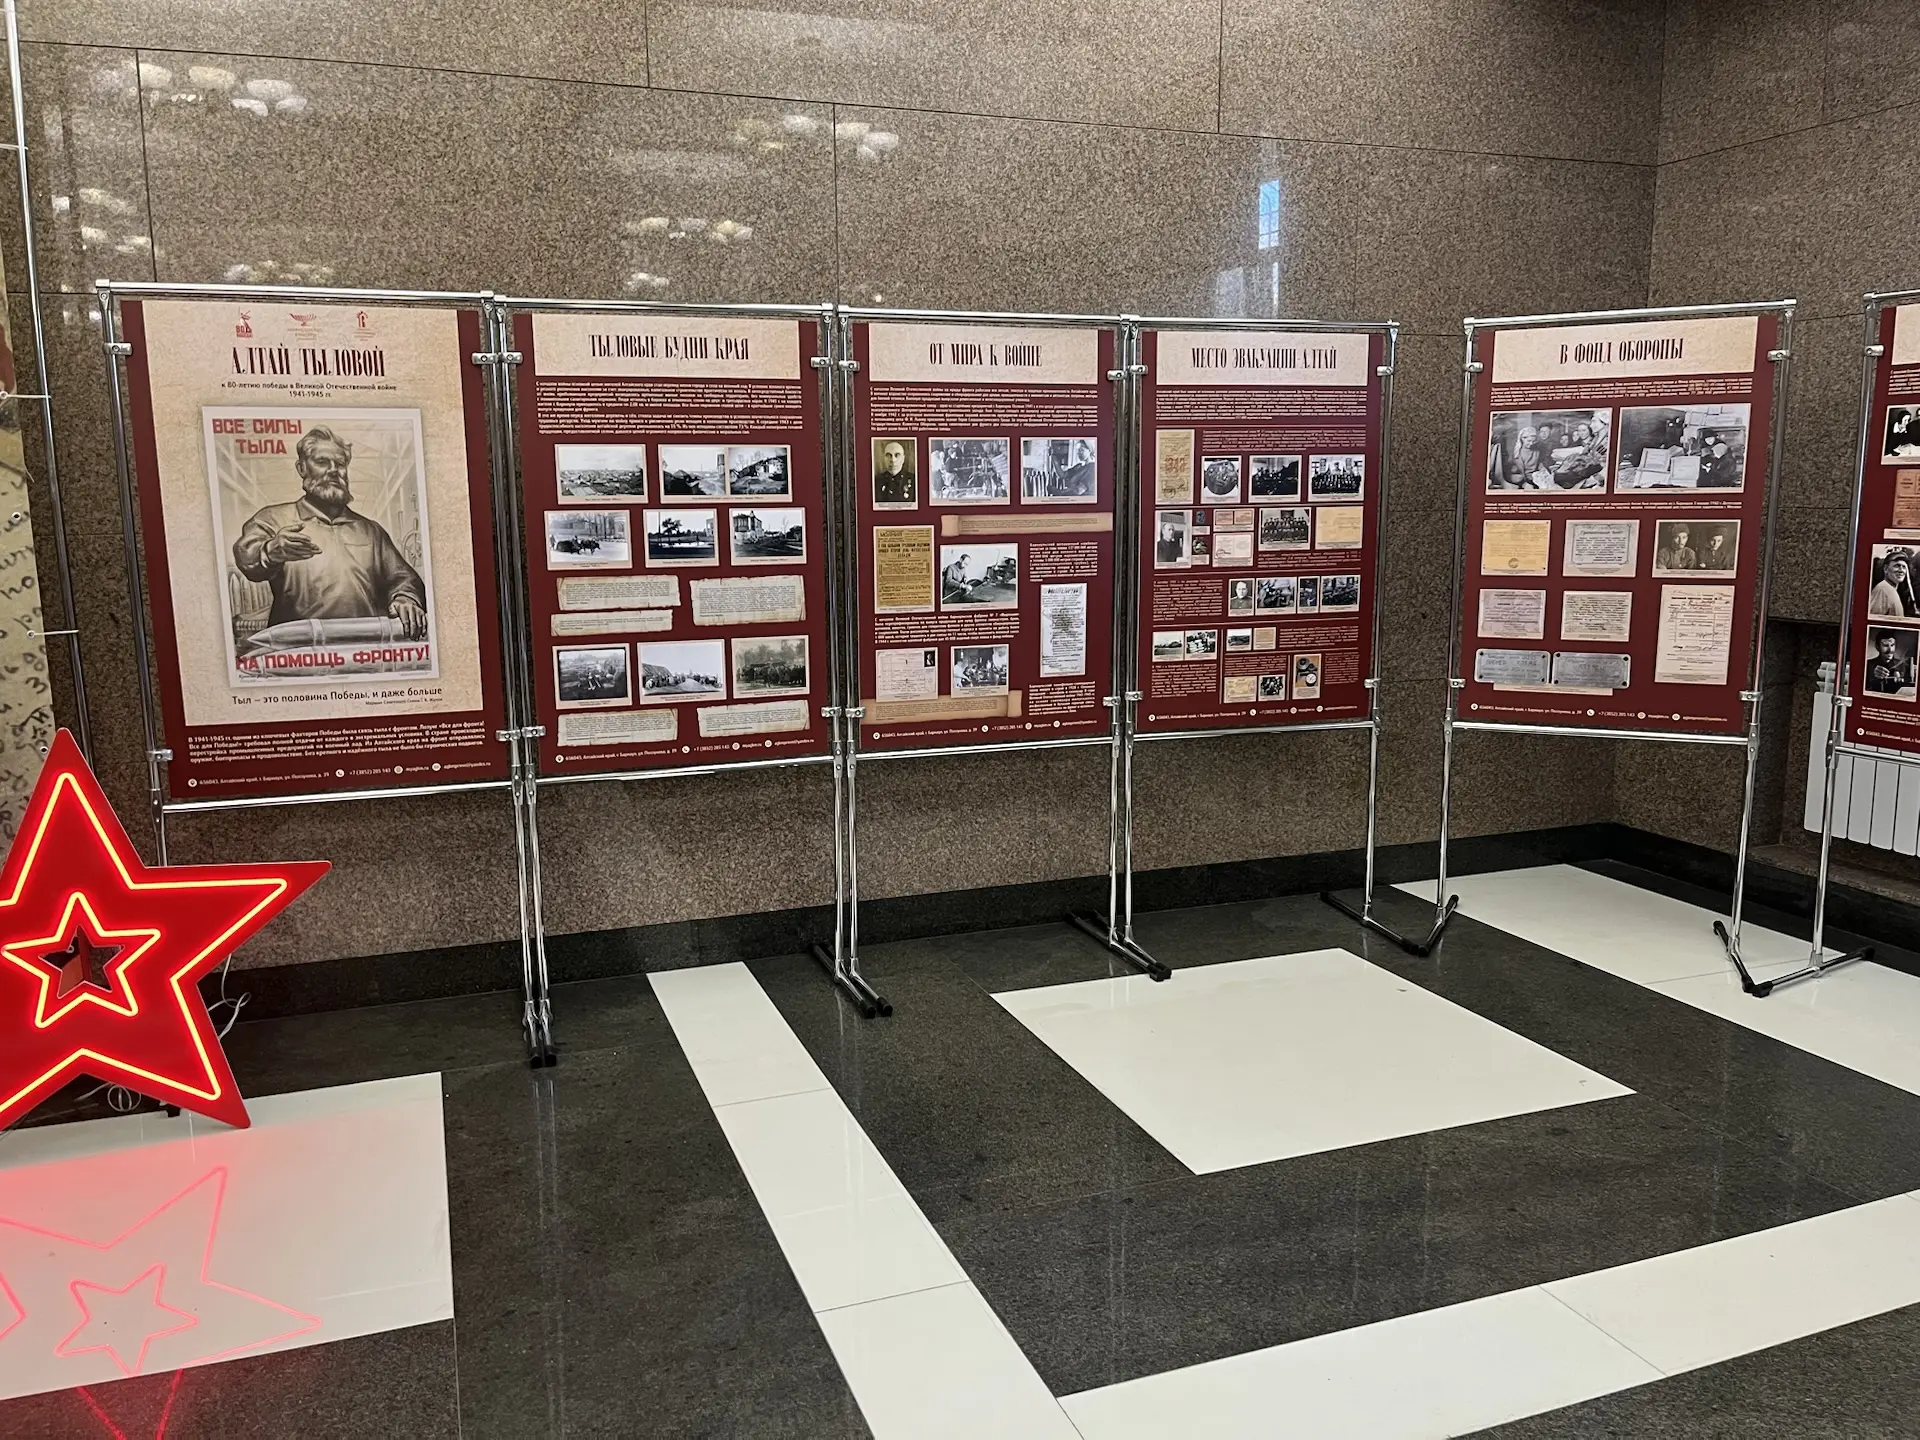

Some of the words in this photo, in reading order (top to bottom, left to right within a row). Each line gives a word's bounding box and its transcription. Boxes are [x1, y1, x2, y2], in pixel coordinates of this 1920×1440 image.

[232, 342, 290, 375] АЛТАЙ
[300, 345, 385, 377] ТЫЛОВОЙ
[588, 334, 659, 358] ТЫЛОВЫЕ
[664, 336, 708, 360] БУДНИ
[715, 337, 749, 360] КРАЯ
[929, 343, 944, 364] ОТ
[951, 344, 983, 365] МИРА
[990, 344, 998, 366] К
[1004, 342, 1042, 367] ВОЙНЕ
[1192, 348, 1227, 369] МЕСТО
[1560, 344, 1568, 364] В
[1574, 342, 1612, 365] ФОНД
[1619, 338, 1684, 362] ОБОРОНЫ
[212, 419, 245, 433] ВСЕ
[252, 419, 302, 434] СИЛЫ
[235, 439, 287, 454] ТЫЛА
[236, 656, 259, 670] НА
[265, 653, 344, 669] ПОМОЩЬ
[353, 644, 430, 664] ФРОНТУ!
[232, 695, 251, 705] Тыл
[281, 694, 328, 702] половина
[330, 691, 369, 702] Победы,
[381, 690, 405, 698] даже
[407, 687, 442, 695] больше
